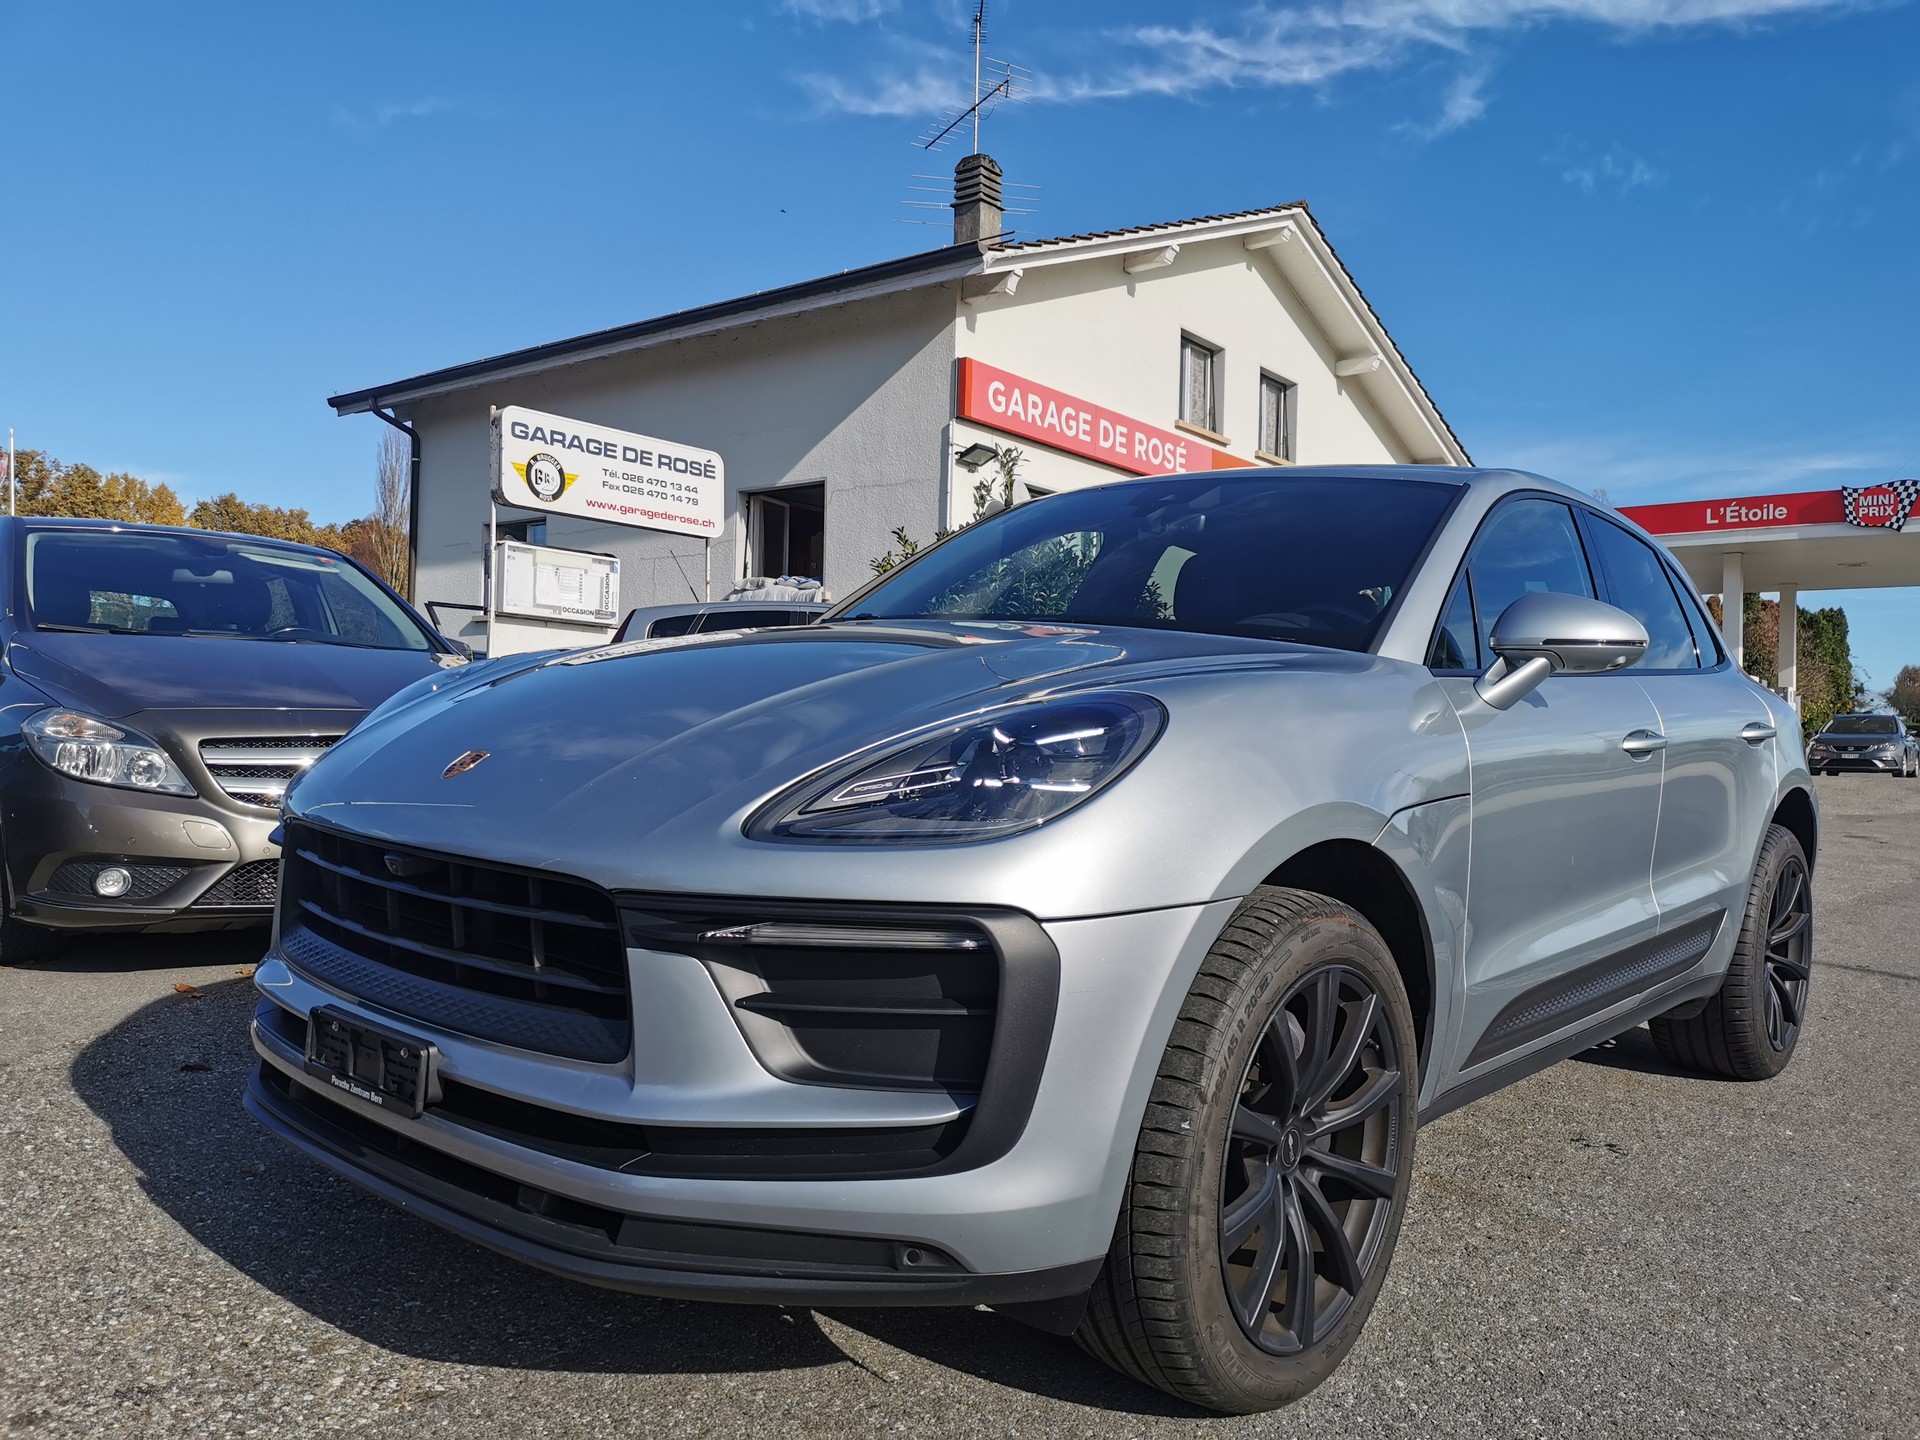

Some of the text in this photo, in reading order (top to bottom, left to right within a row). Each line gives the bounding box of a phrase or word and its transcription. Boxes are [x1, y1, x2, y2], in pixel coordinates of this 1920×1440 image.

[987, 380, 1187, 473] GARAGE DE ROSÉ
[511, 421, 716, 480] GARAGE DE ROSÉ
[602, 468, 699, 494] Tél. 026 470 13 44
[602, 480, 699, 506] Fax 026 470 14 79
[1705, 501, 1788, 525] L'Étoile
[1858, 493, 1895, 507] MINI
[1858, 505, 1894, 518] PRIX
[585, 498, 716, 529] www.garagederose.ch
[562, 606, 595, 616] OCCASION
[331, 1074, 383, 1105] Porsche Zentrum Bern
